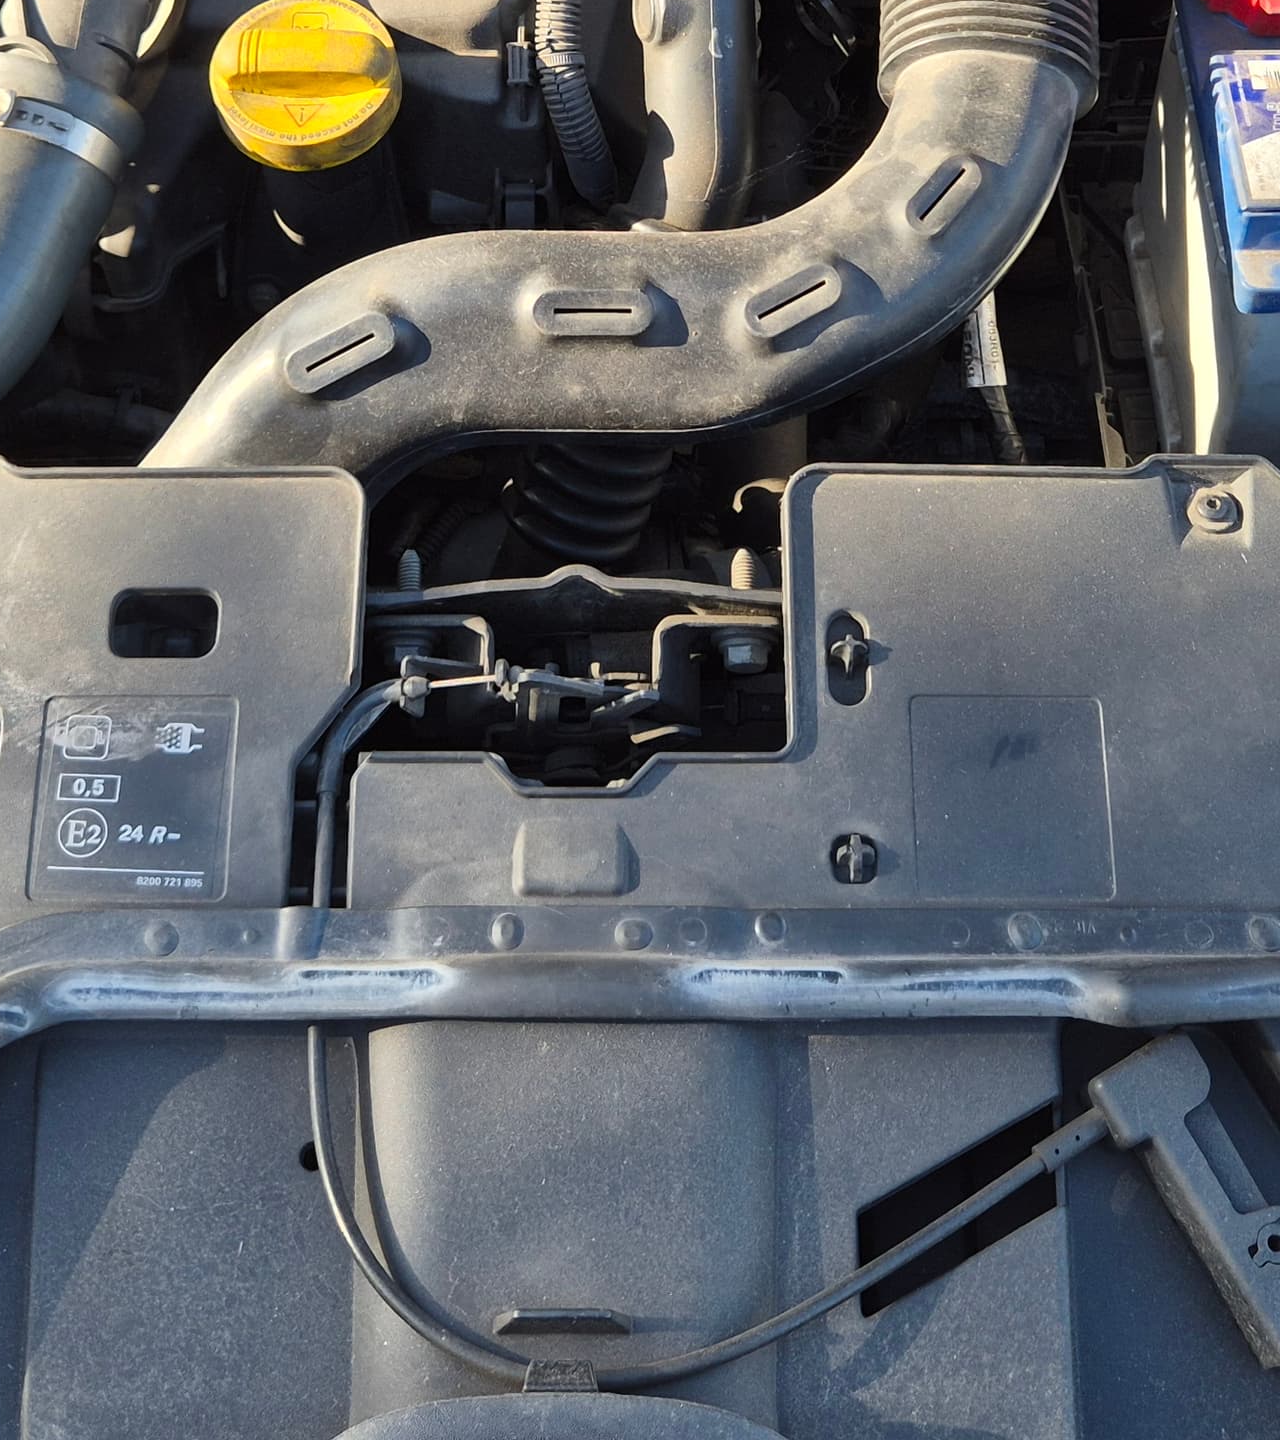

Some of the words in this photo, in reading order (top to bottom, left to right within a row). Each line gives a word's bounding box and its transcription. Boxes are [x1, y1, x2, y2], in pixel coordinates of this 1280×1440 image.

[73, 778, 104, 797] 0,5
[65, 819, 101, 847] E2
[118, 824, 144, 842] 24
[136, 876, 161, 886] 8200
[164, 877, 181, 887] 721
